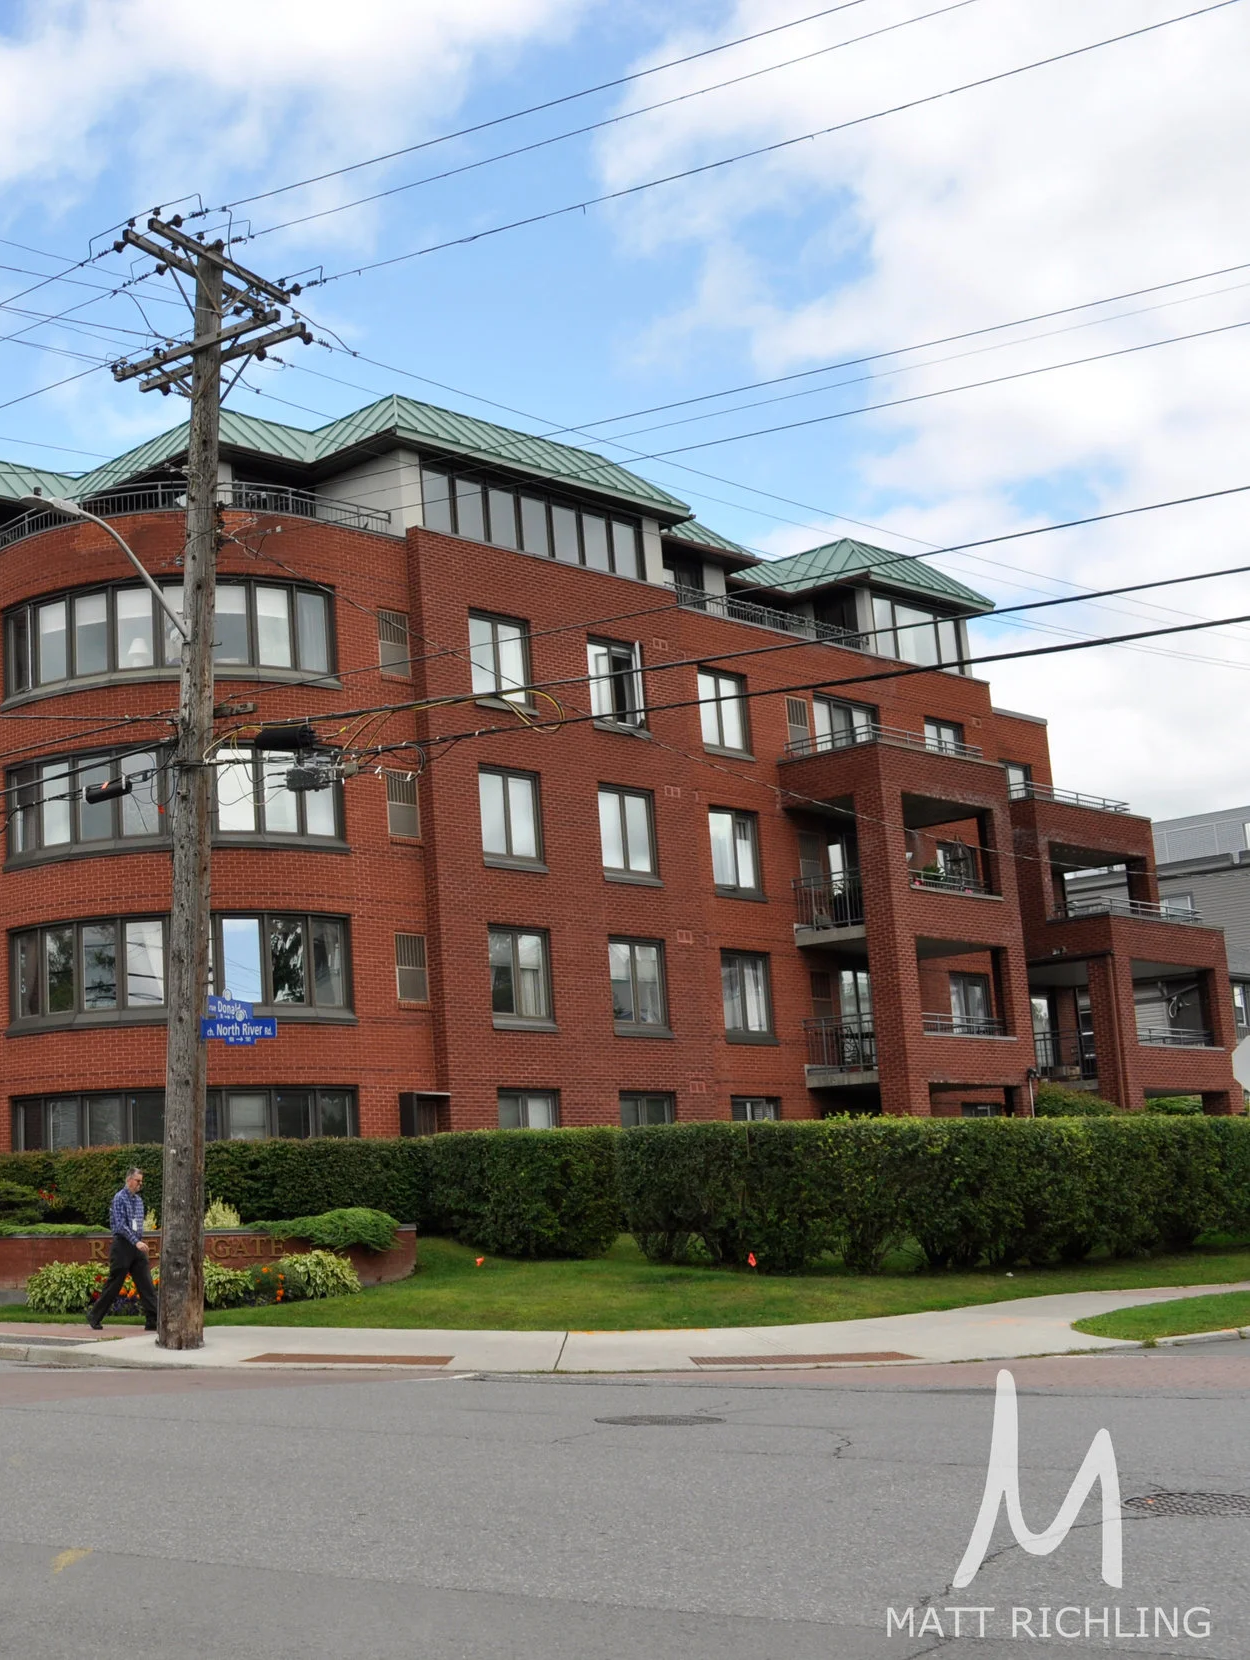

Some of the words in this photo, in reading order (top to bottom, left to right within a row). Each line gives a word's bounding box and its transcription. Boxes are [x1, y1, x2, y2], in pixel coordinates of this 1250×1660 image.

[217, 1022, 240, 1036] North
[243, 1022, 263, 1036] River
[211, 1236, 286, 1258] GATE
